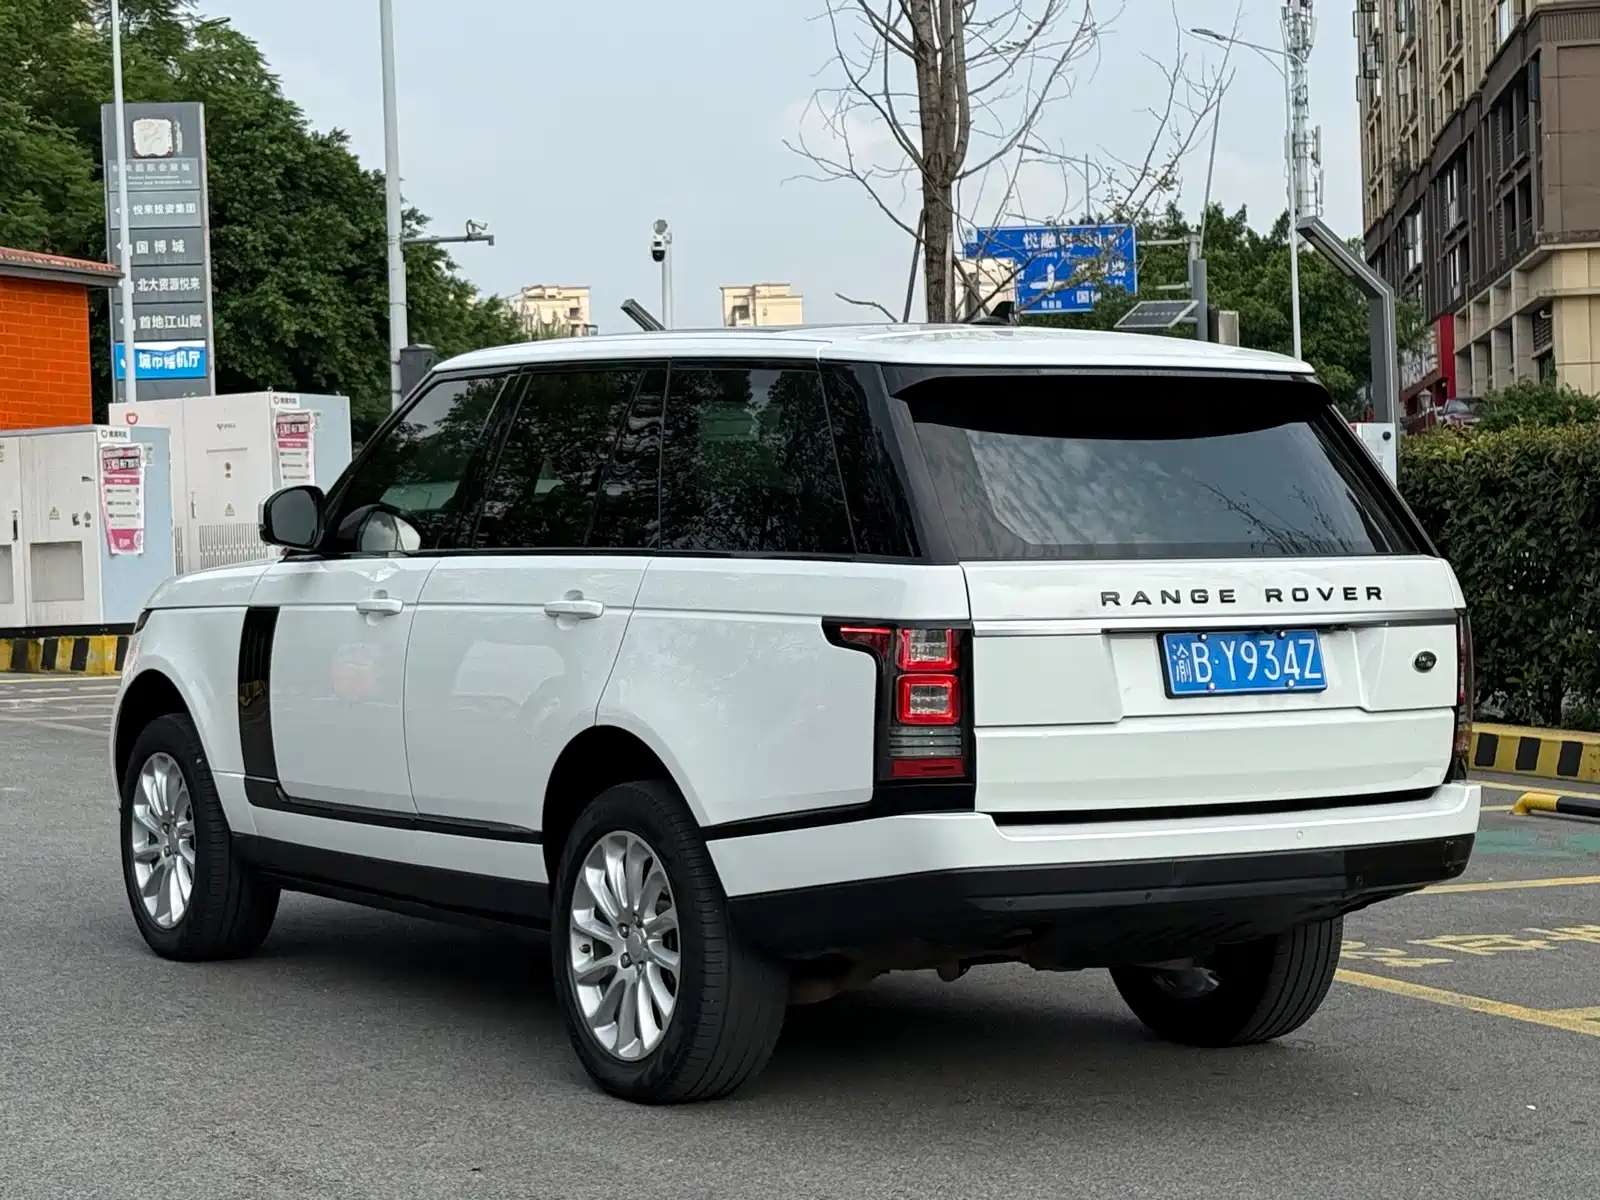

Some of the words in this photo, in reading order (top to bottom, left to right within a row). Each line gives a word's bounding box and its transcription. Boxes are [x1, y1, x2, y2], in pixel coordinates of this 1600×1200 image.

[136, 239, 185, 254] 国博城
[138, 278, 200, 291] 北大资源悦来
[1100, 588, 1237, 607] RANGE
[1264, 586, 1384, 602] ROVER
